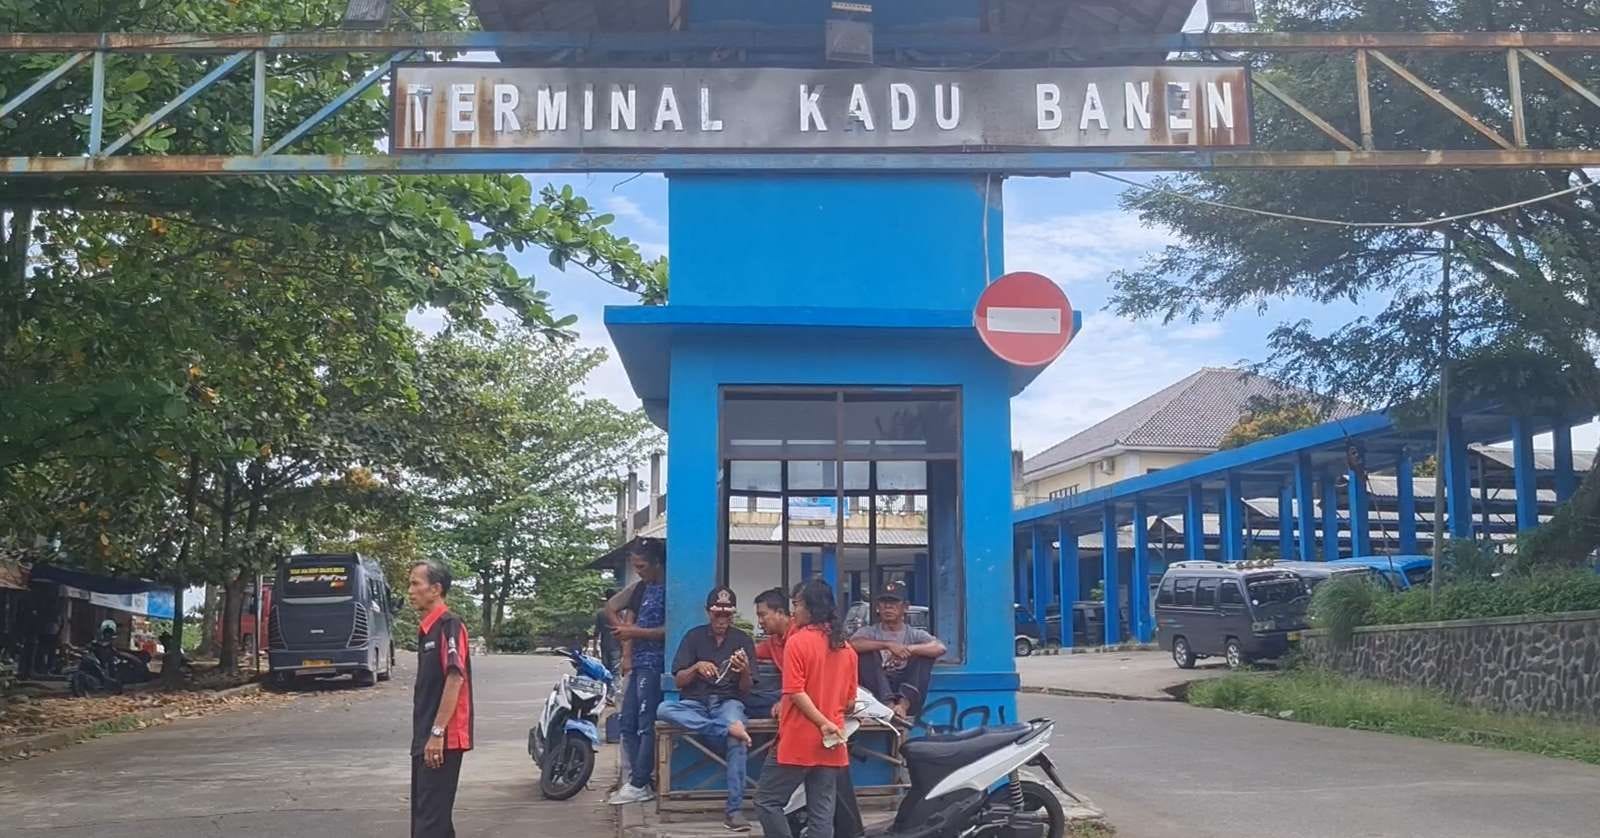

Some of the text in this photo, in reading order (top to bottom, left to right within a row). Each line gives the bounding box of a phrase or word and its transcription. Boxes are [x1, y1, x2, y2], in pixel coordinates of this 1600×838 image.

[407, 81, 1234, 132] TERMINAL KADU BANEN
